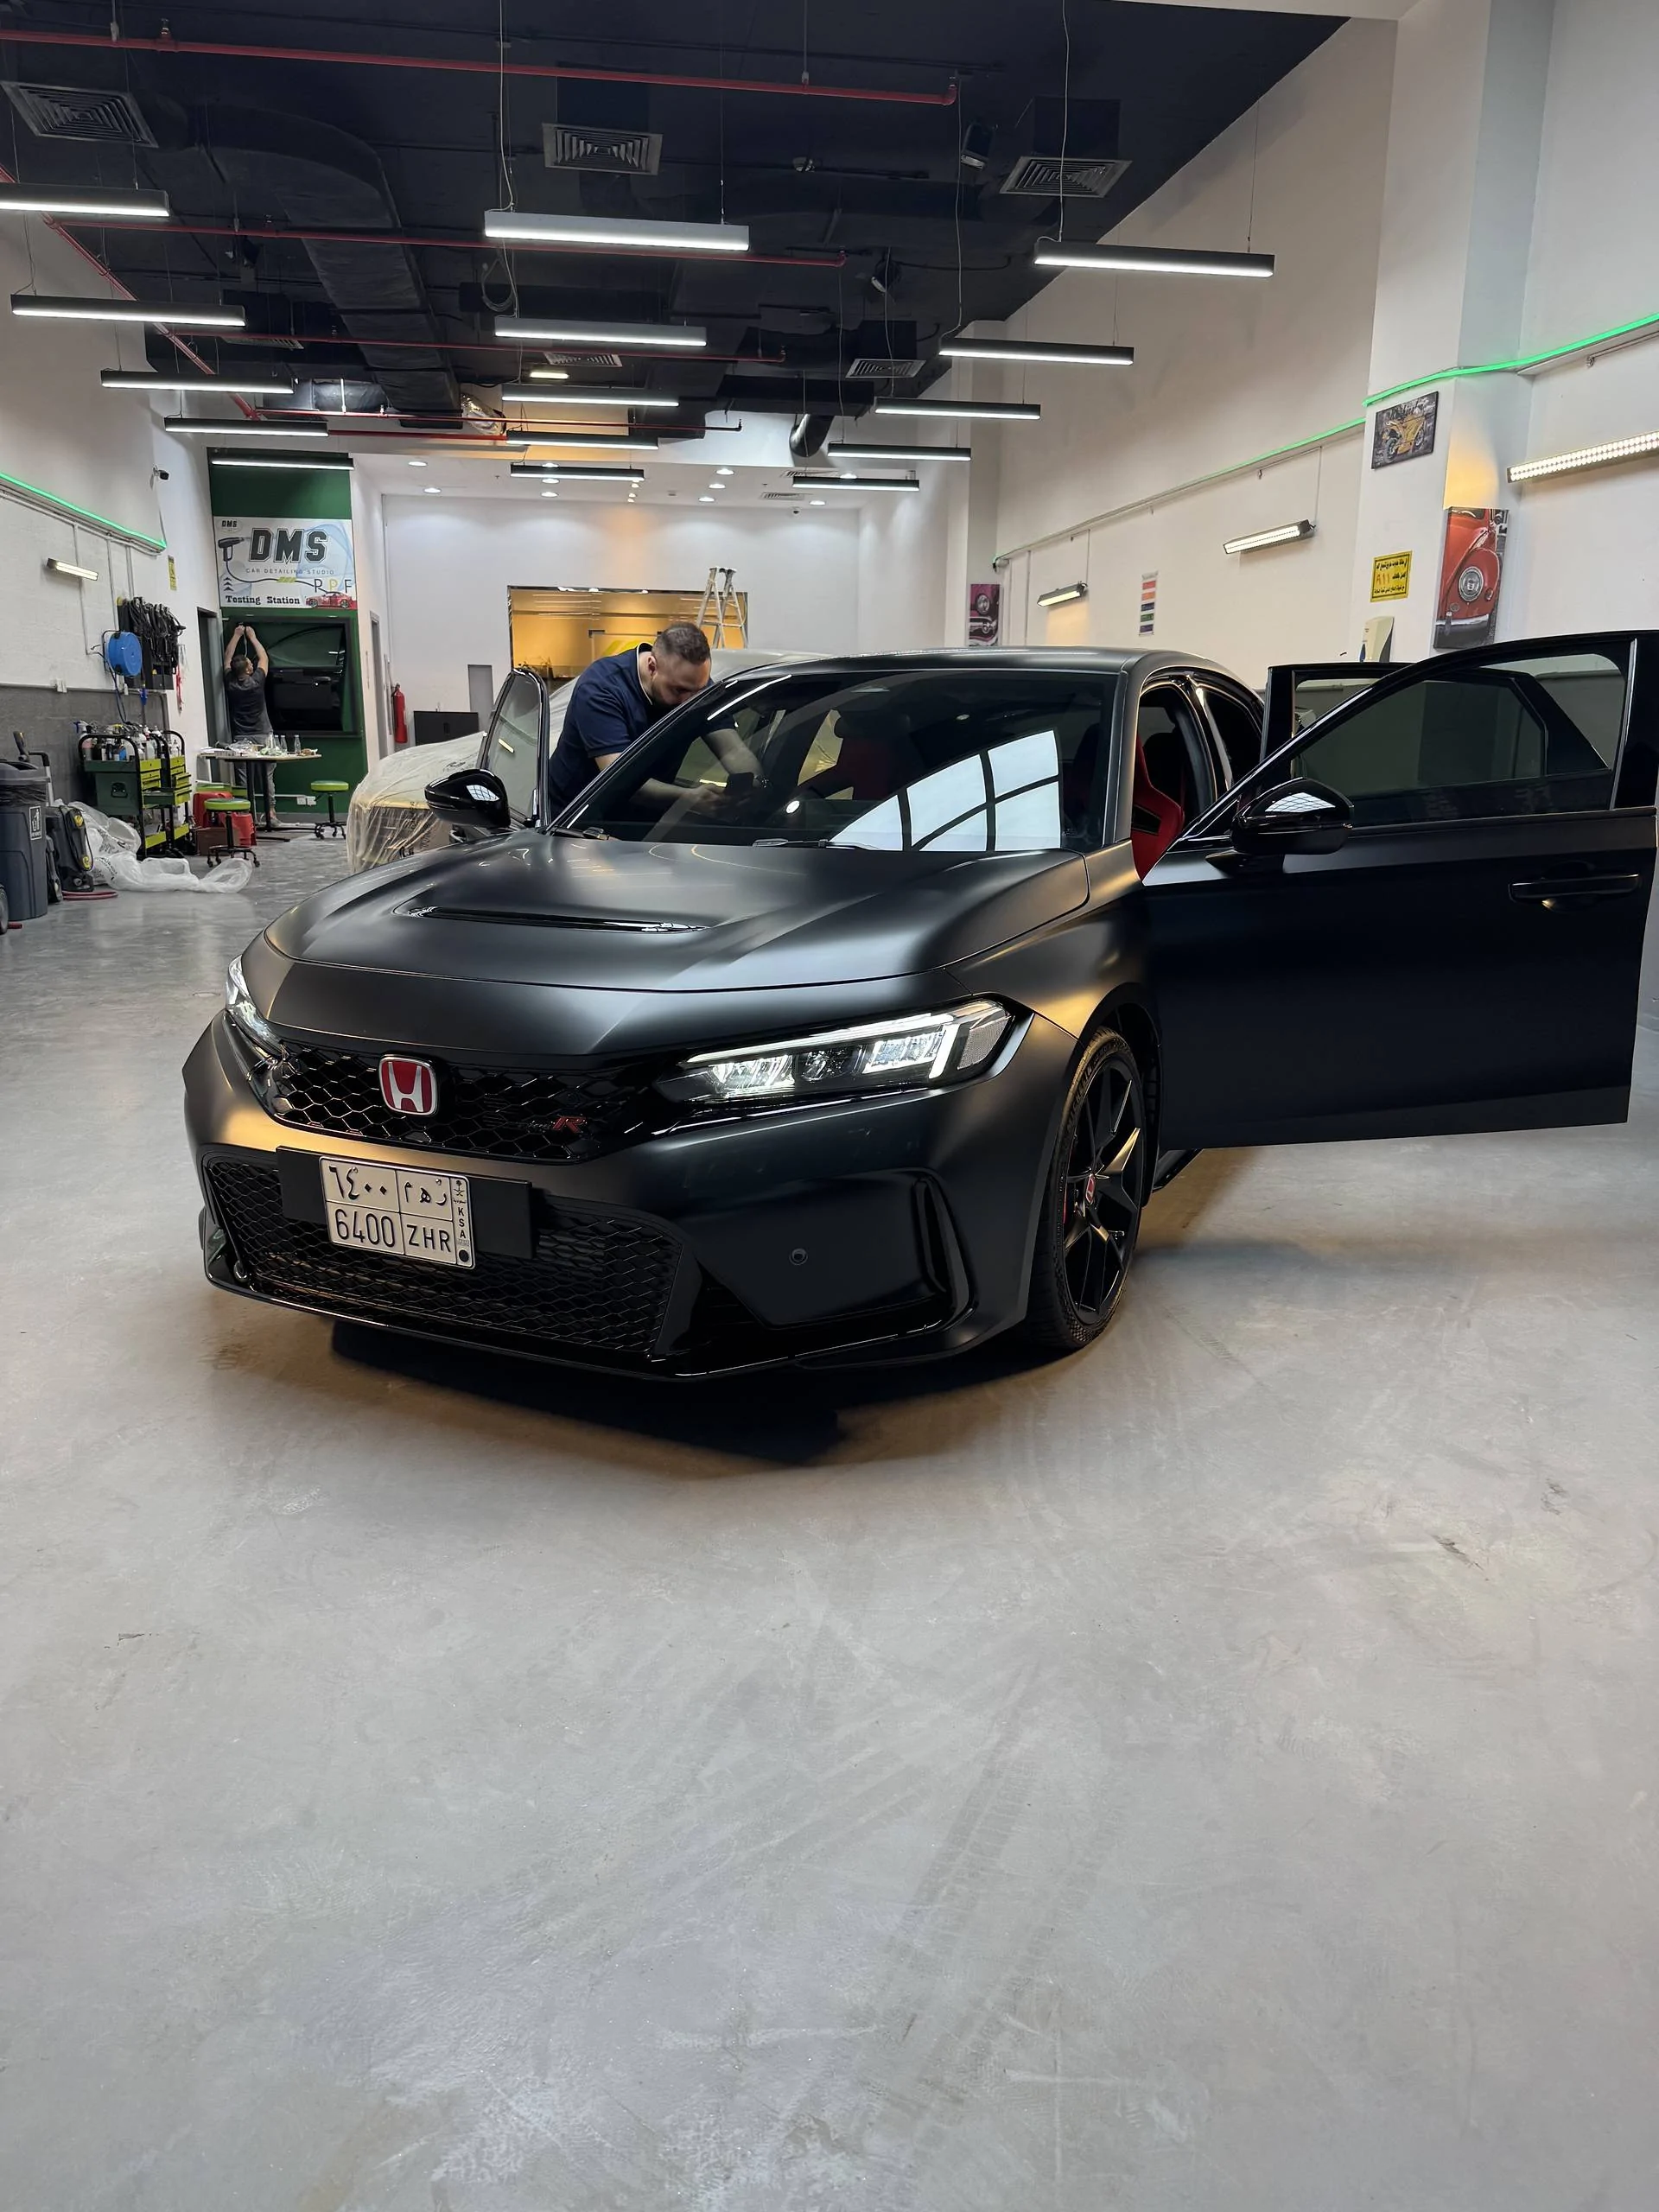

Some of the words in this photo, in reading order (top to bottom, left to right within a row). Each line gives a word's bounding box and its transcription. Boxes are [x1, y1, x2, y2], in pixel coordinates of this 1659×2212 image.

[248, 527, 329, 564] DMS
[226, 595, 261, 605] Testing
[266, 596, 300, 605] Station
[334, 1209, 396, 1248] 6400
[406, 1224, 451, 1253] ZHR
